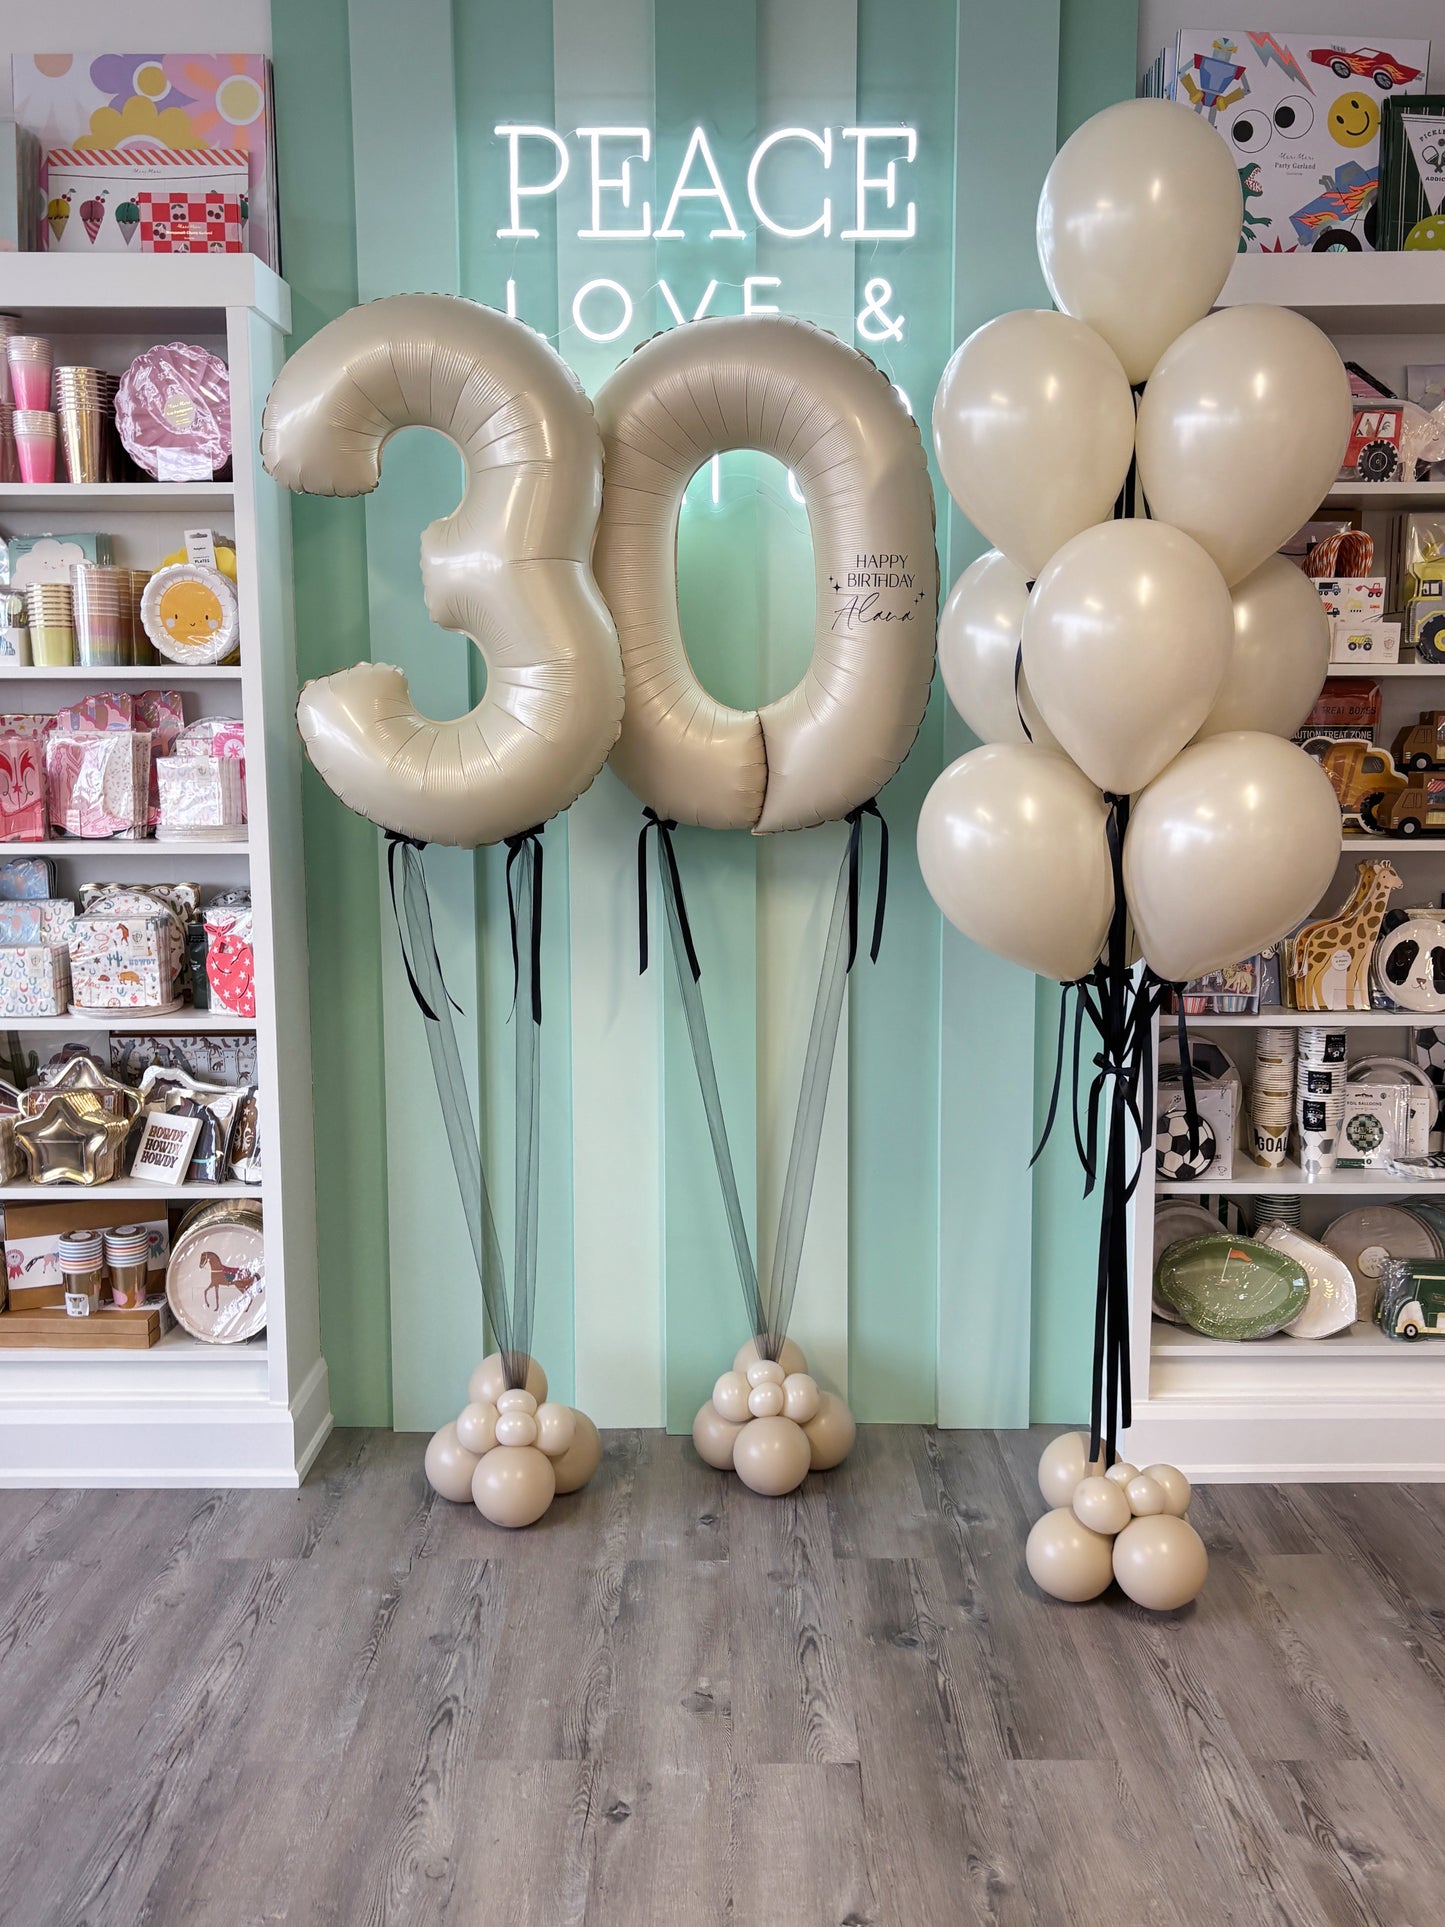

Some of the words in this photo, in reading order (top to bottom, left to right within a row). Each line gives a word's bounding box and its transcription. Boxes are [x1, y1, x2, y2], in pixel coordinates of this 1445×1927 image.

[1275, 162, 1290, 170] Party
[494, 124, 917, 240] PEACE
[857, 277, 906, 342] &
[856, 554, 908, 569] HAPPY
[847, 573, 916, 588] BIRTHDAY
[1322, 705, 1345, 715] TREAT
[1349, 706, 1377, 715] BOXES
[1295, 730, 1321, 739] UTION
[1323, 730, 1348, 739] TREAT
[1350, 730, 1373, 740] ZONE
[148, 1125, 187, 1142] HOWDY
[144, 1138, 183, 1155] HOWDY
[140, 1150, 179, 1168] HOWDY
